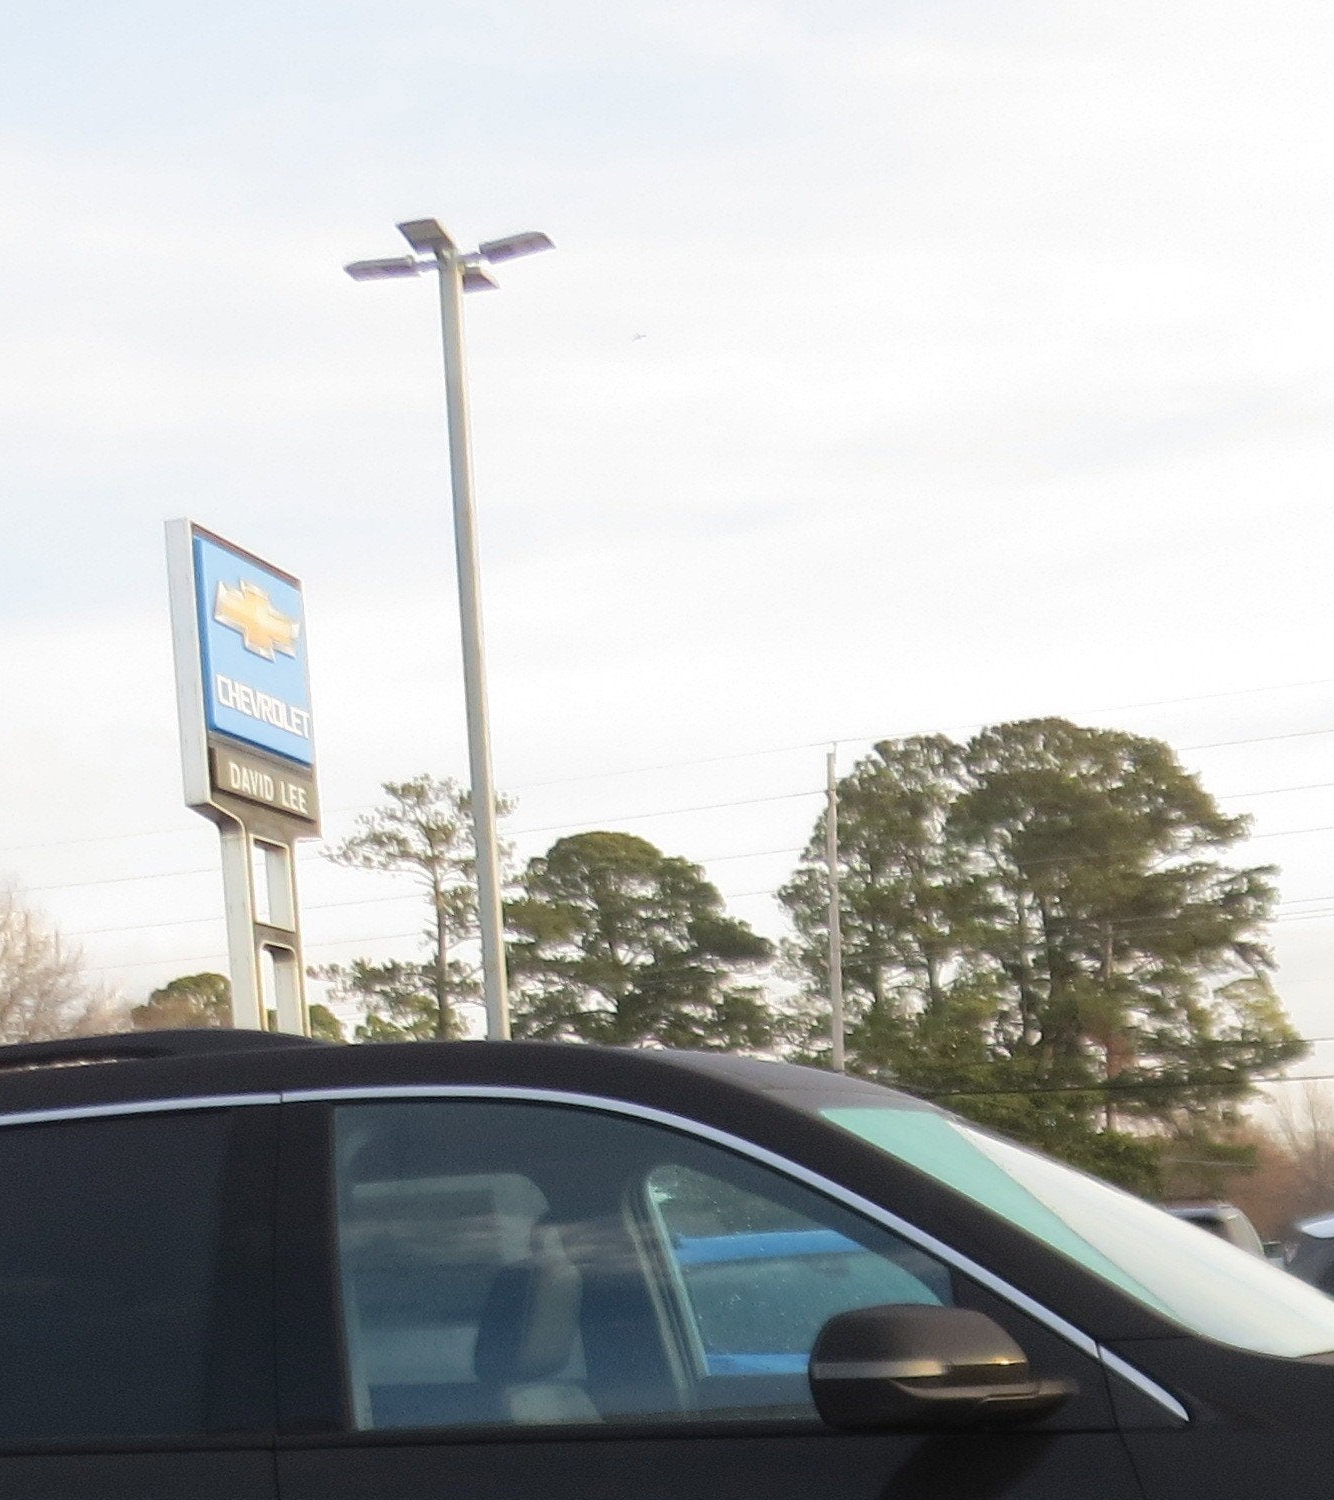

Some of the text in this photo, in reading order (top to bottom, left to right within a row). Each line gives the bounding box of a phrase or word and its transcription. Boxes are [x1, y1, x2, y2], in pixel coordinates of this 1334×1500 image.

[216, 674, 310, 740] CHEVROLET
[229, 761, 308, 815] DAVID LEE
